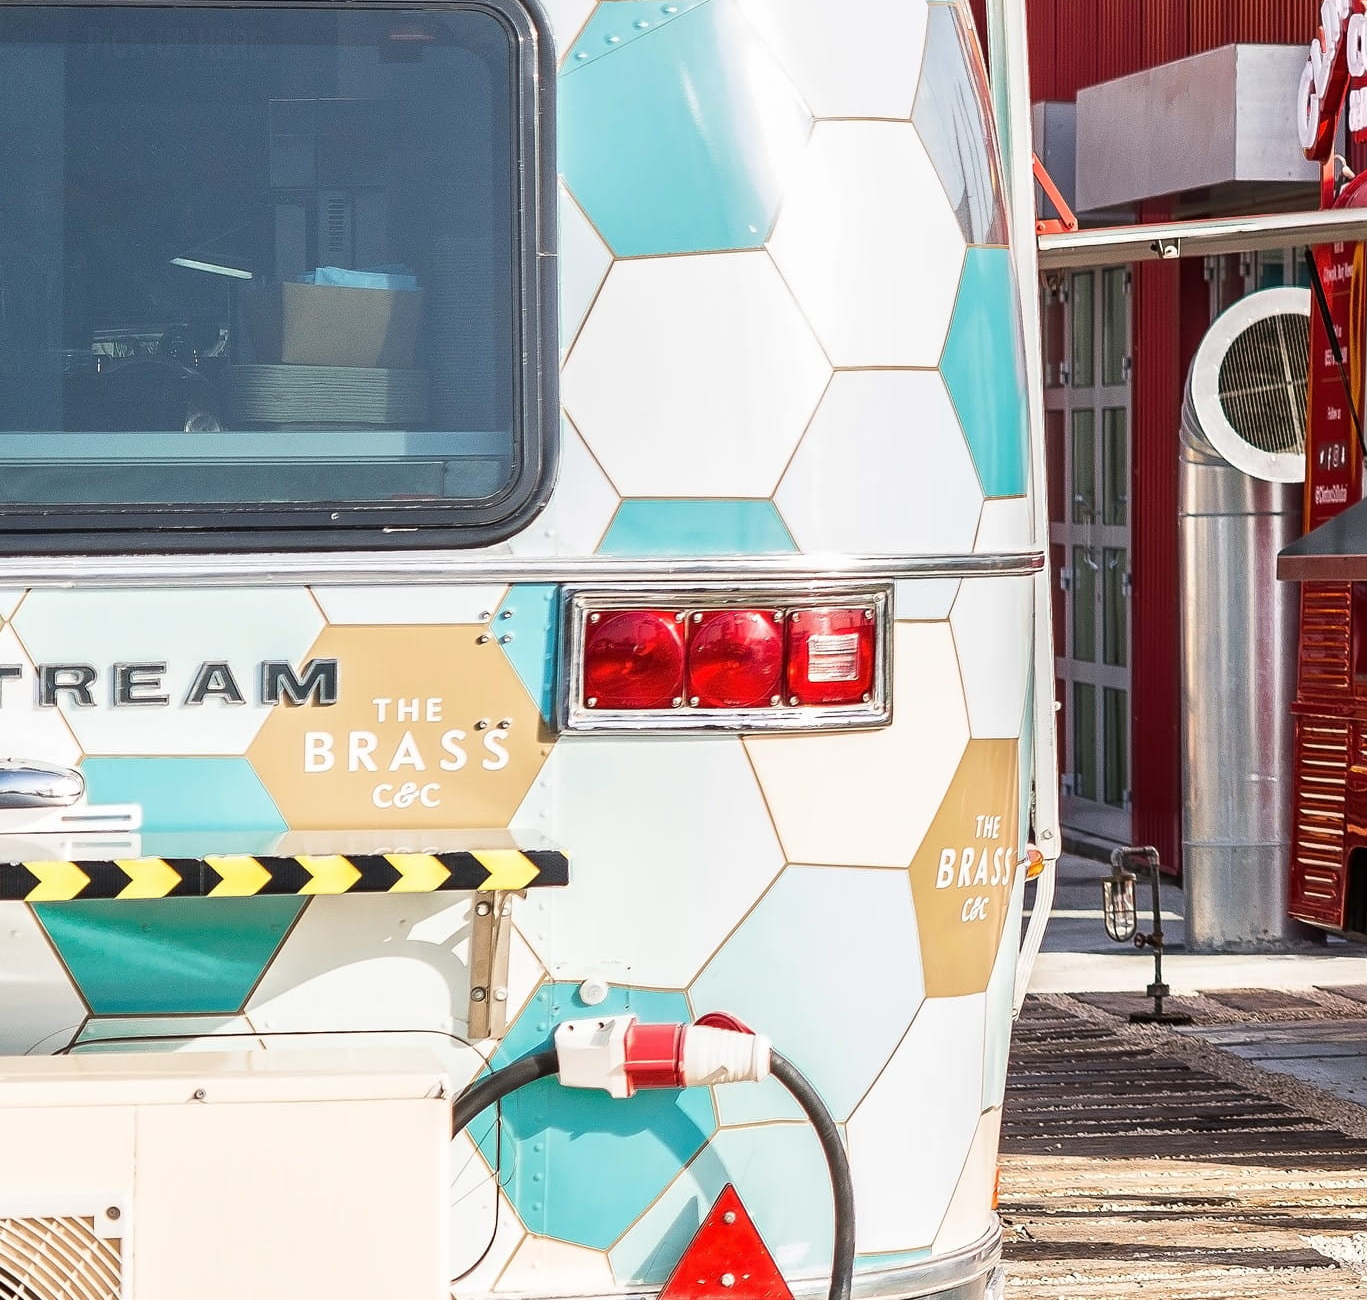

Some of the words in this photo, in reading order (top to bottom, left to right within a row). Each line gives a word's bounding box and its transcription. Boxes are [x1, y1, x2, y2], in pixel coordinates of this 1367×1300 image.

[372, 697, 443, 723] THE
[304, 729, 510, 773] BRASS
[372, 781, 441, 808] C&C
[975, 814, 1001, 839] THE
[935, 846, 1013, 889] BRASS
[961, 895, 990, 923] C&C
